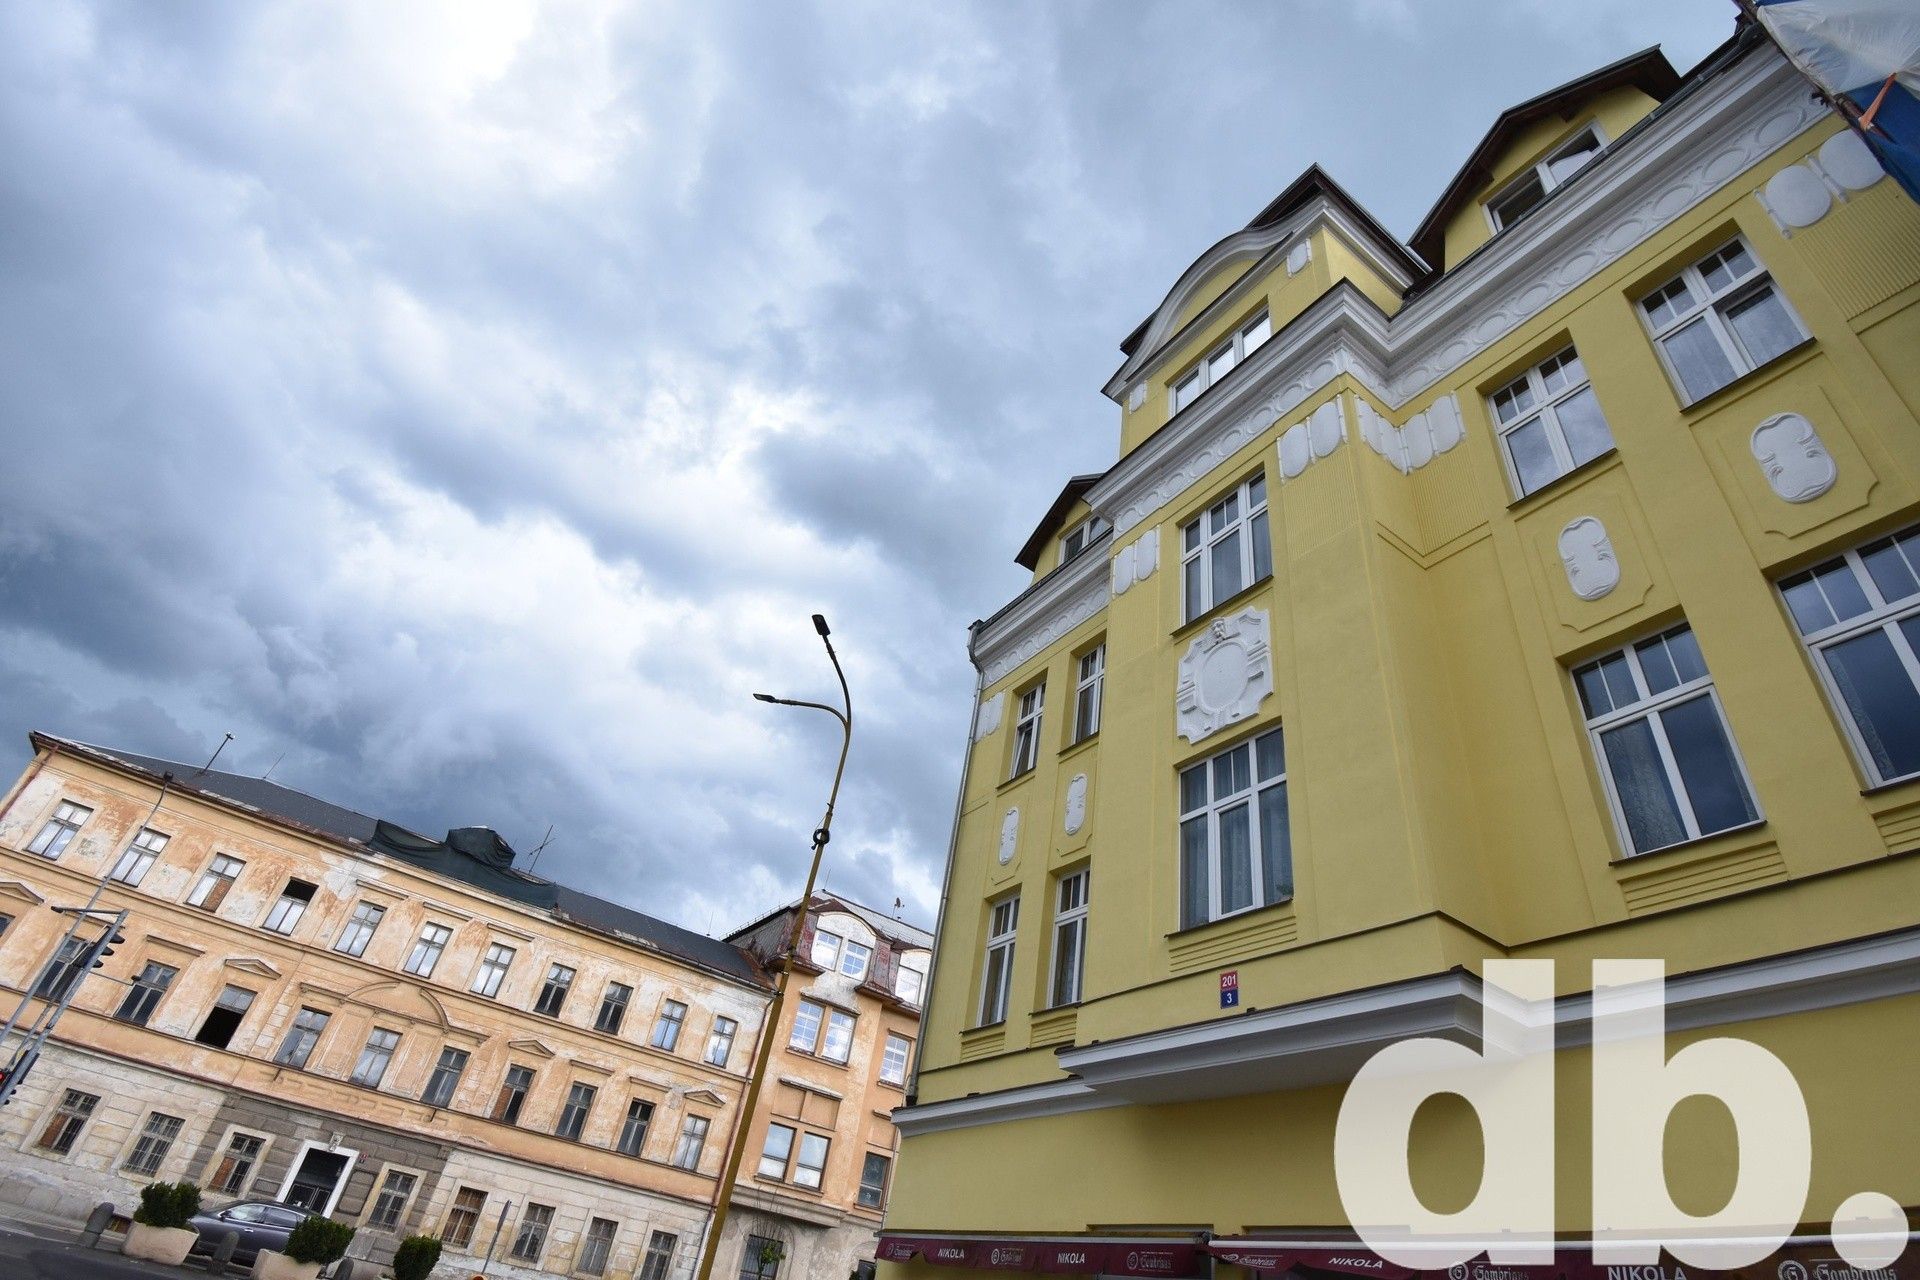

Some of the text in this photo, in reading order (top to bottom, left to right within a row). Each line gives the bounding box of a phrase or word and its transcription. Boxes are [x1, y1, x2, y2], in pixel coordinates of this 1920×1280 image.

[1222, 974, 1236, 987] 201
[1227, 992, 1233, 1004] 3
[938, 1248, 965, 1259] NIKOLA
[1057, 1253, 1085, 1264] NIKOLA
[1328, 1257, 1384, 1269] NIKOLA
[1607, 1266, 1689, 1280] NIKOLA
